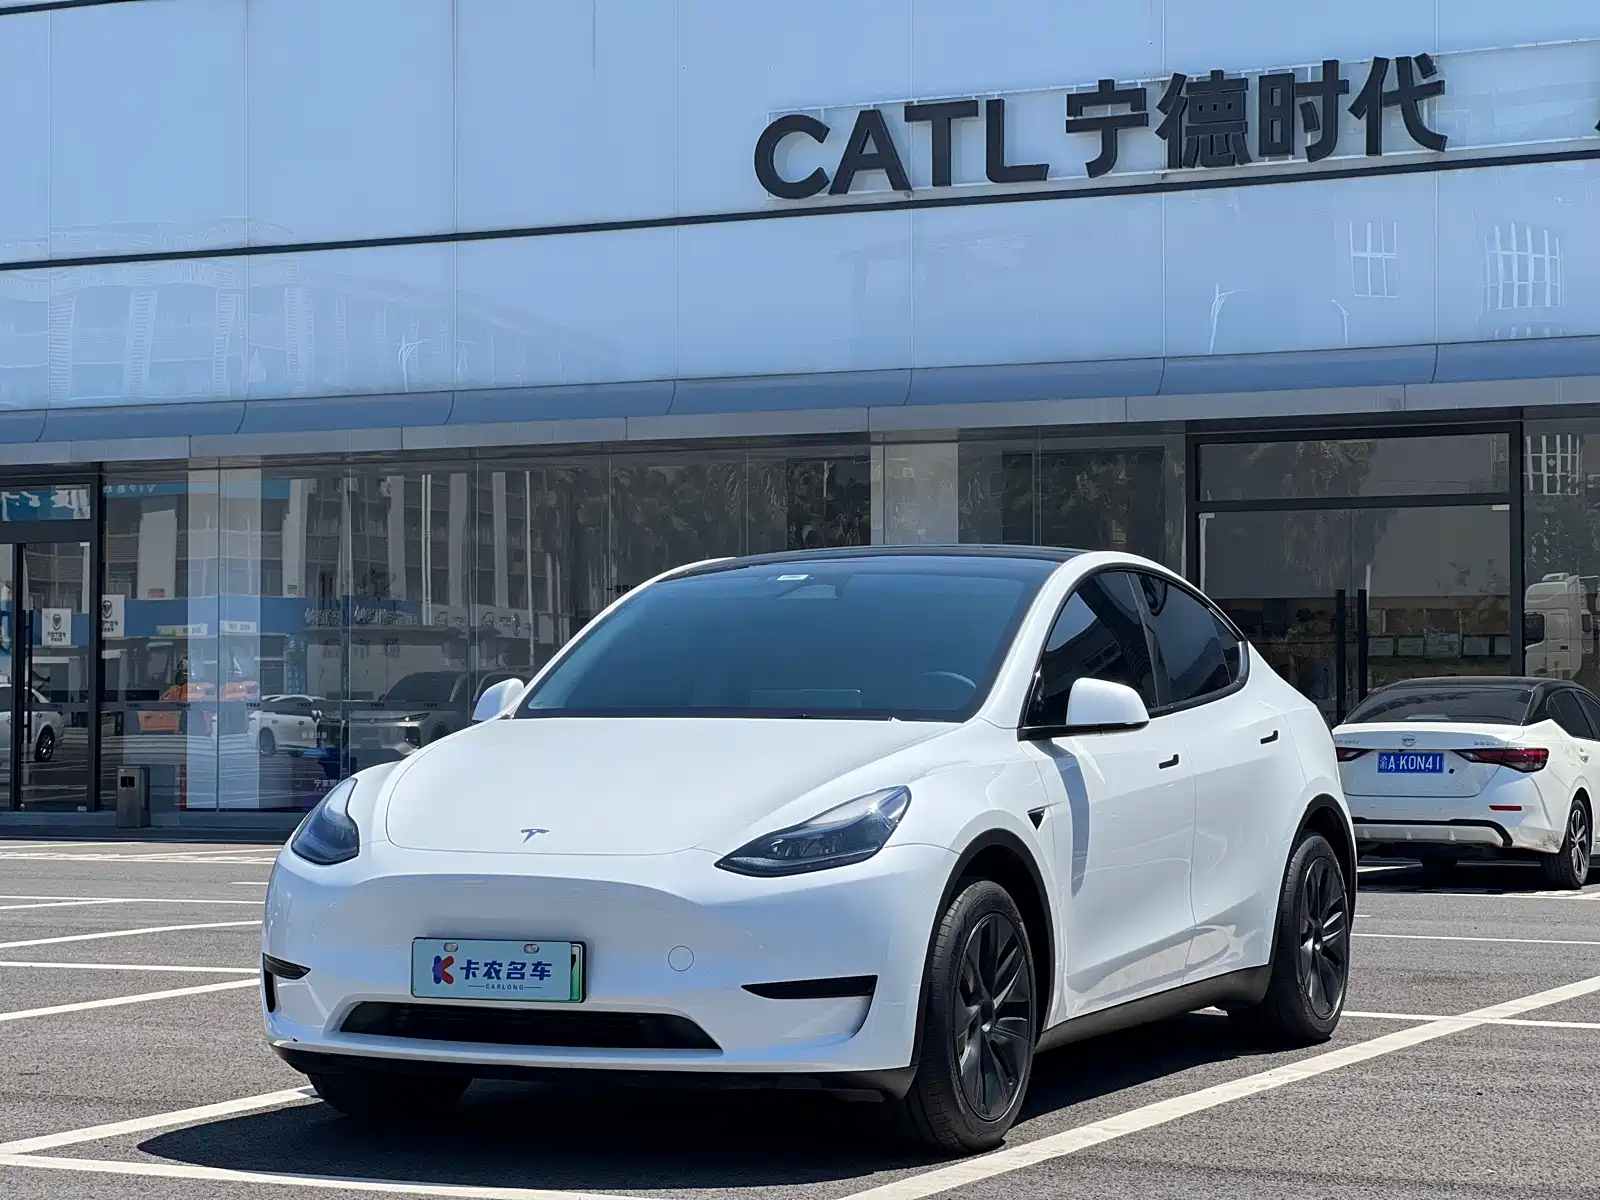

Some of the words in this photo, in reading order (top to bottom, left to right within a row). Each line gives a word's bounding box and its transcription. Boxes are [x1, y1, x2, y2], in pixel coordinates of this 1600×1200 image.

[754, 98, 1049, 200] CATL
[1064, 52, 1447, 178] 宁德时代
[460, 959, 552, 980] 卡农名车
[485, 983, 525, 991] CARLONG
